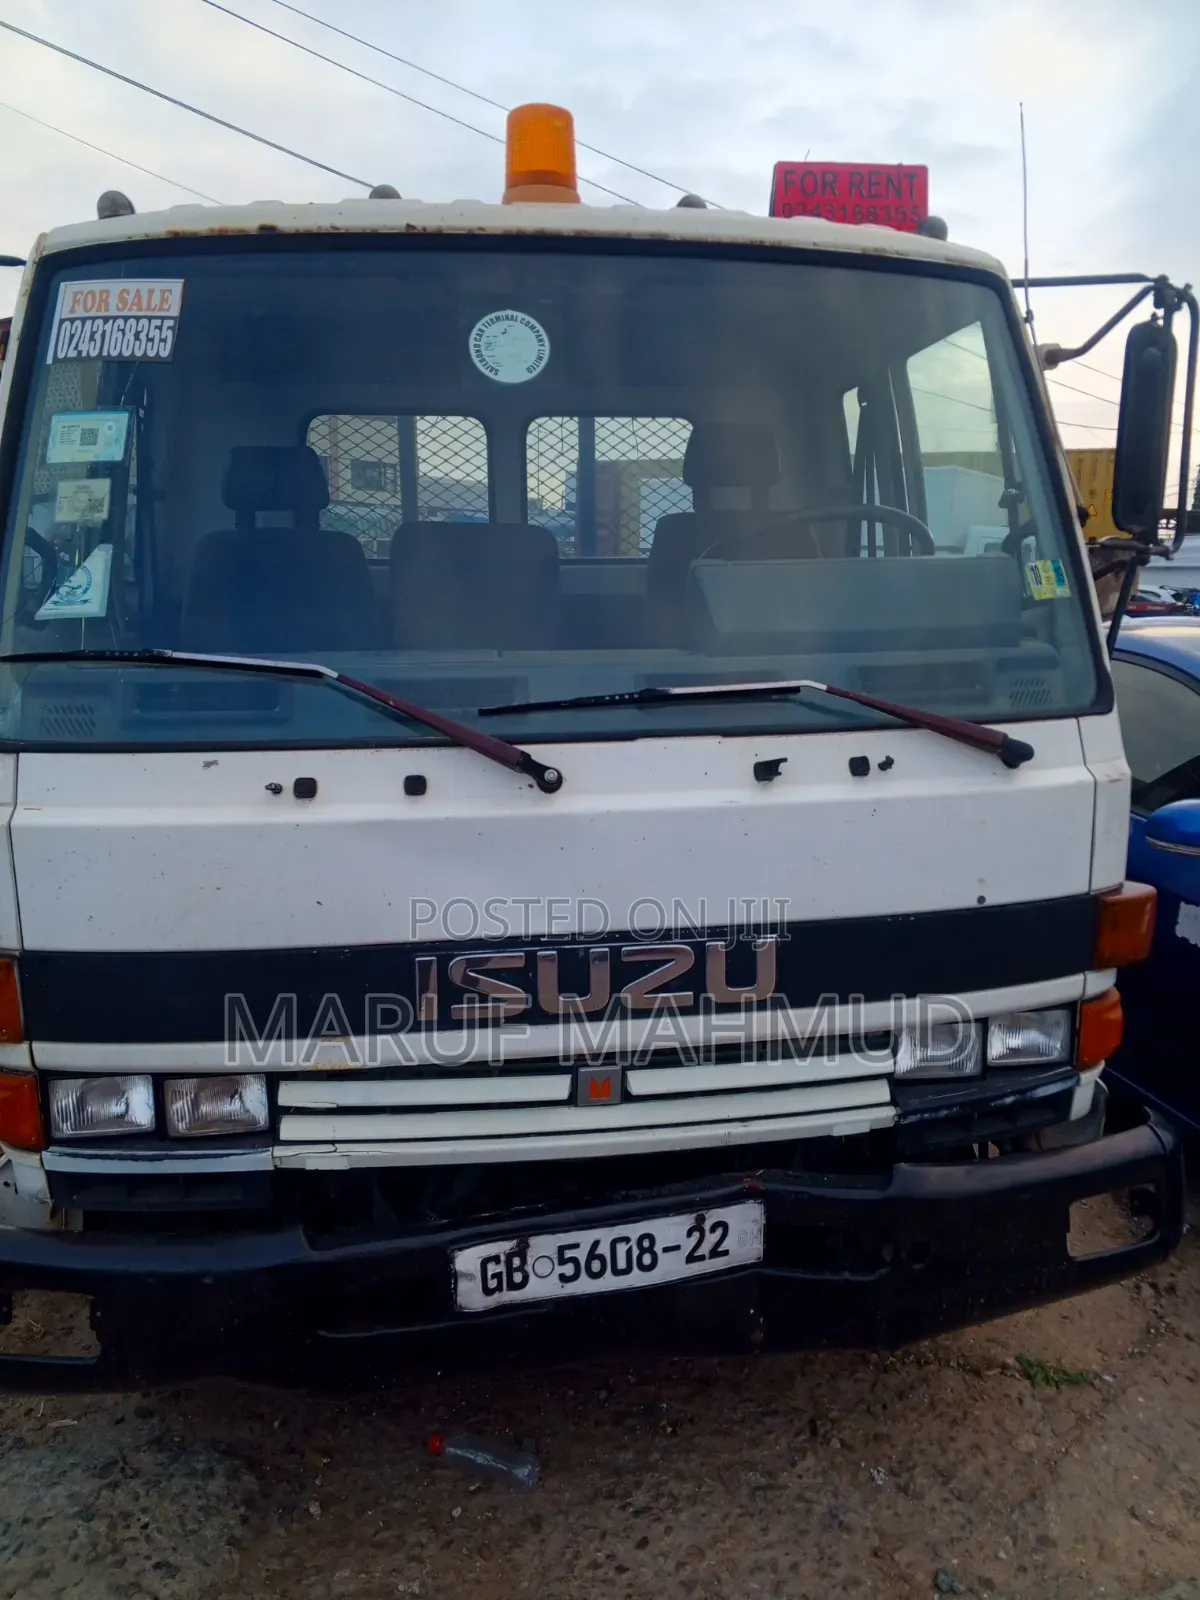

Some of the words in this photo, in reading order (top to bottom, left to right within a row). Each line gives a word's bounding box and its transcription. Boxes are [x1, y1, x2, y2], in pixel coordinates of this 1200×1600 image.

[783, 170, 839, 198] FOR
[850, 171, 919, 200] RENT
[69, 289, 111, 314] FOR
[116, 288, 172, 312] SALE
[481, 314, 518, 329] TERMINAL
[520, 317, 545, 347] COMPANY
[56, 318, 175, 359] 0243168355
[526, 348, 545, 374] LIMITED
[415, 934, 778, 1021] ISUZU
[480, 1250, 531, 1296] GB
[557, 1220, 729, 1284] 5608-22
